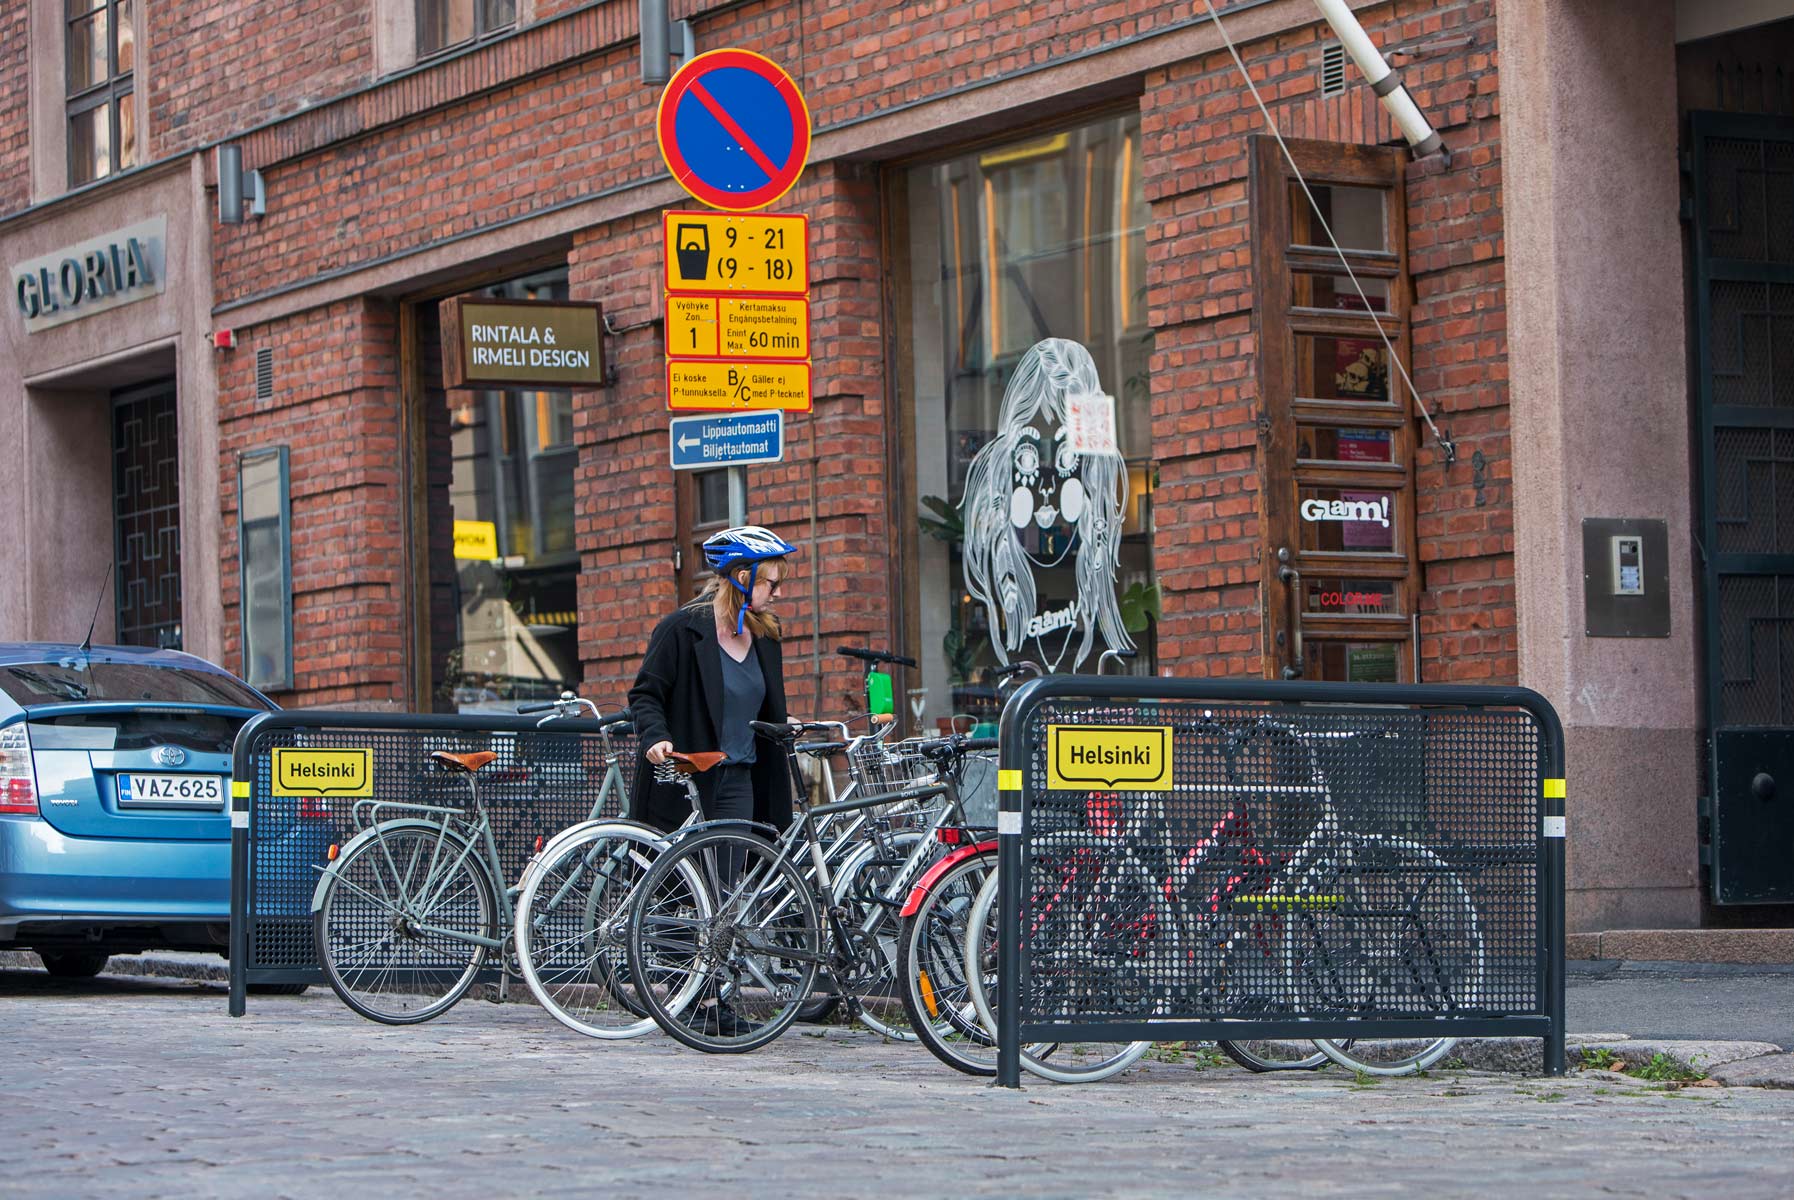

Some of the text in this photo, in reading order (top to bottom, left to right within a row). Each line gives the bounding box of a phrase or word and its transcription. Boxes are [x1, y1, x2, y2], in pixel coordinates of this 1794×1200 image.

[726, 227, 737, 248] 9
[764, 228, 784, 250] 21
[717, 257, 737, 279] (9
[764, 258, 793, 280] 18)
[17, 238, 154, 319] GLORIA
[676, 302, 709, 310] Vyöhyke
[740, 303, 786, 312] Kertamaksu
[685, 313, 700, 321] Zon
[729, 314, 797, 325] Engångsbetalning
[471, 324, 556, 345] RINTALA &
[690, 328, 696, 349] 1
[749, 331, 800, 349] 60 min
[472, 347, 590, 368] IRMELI DESIGN
[673, 373, 707, 383] Ei koske
[752, 374, 786, 385] Gäller ej
[673, 387, 727, 397] P-tunnuksella
[752, 389, 804, 398] med P-tecknet
[702, 420, 777, 440] Lippuautomaatti
[703, 439, 769, 459] Biljettautomat
[1301, 496, 1390, 528] Glam!
[1027, 600, 1077, 638] Glam!
[1071, 745, 1150, 764] Helsinki
[290, 762, 355, 777] Helsinki
